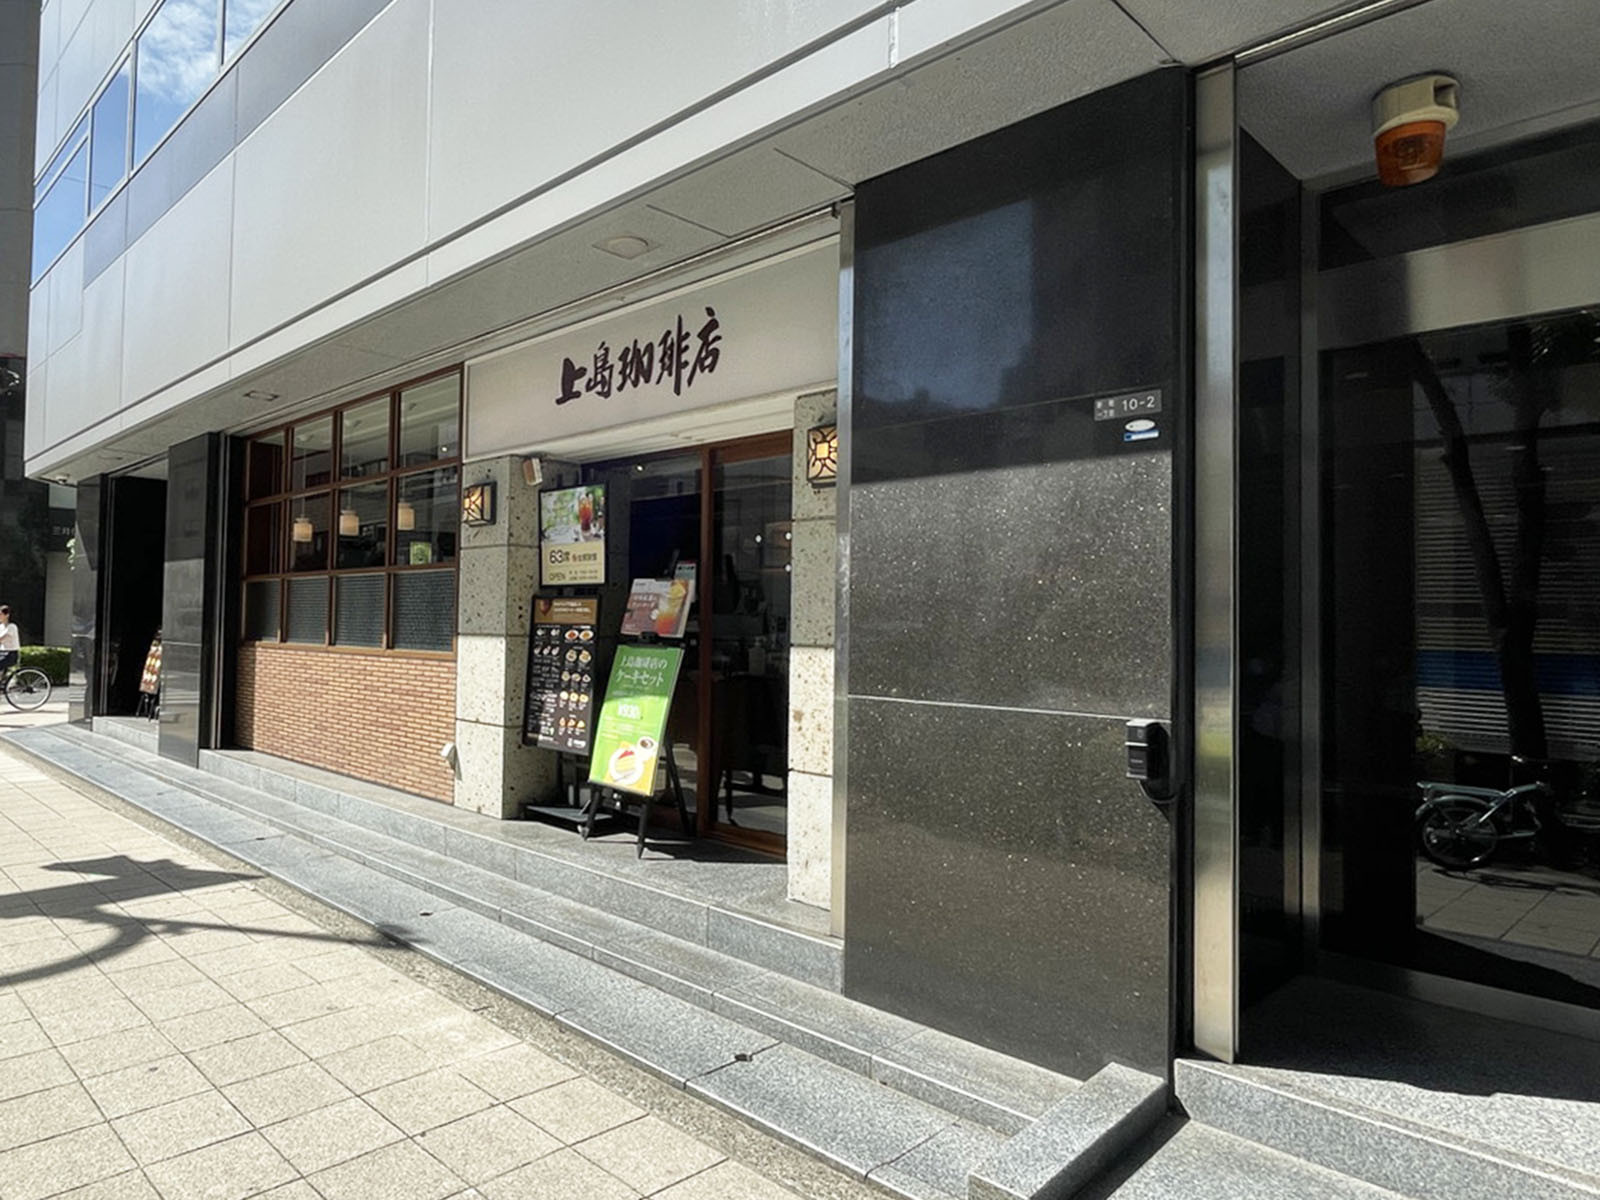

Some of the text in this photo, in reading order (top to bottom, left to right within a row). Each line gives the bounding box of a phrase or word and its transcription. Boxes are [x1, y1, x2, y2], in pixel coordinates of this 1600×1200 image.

[555, 306, 722, 405] 上島珈琲店
[1122, 395, 1155, 412] 10-2
